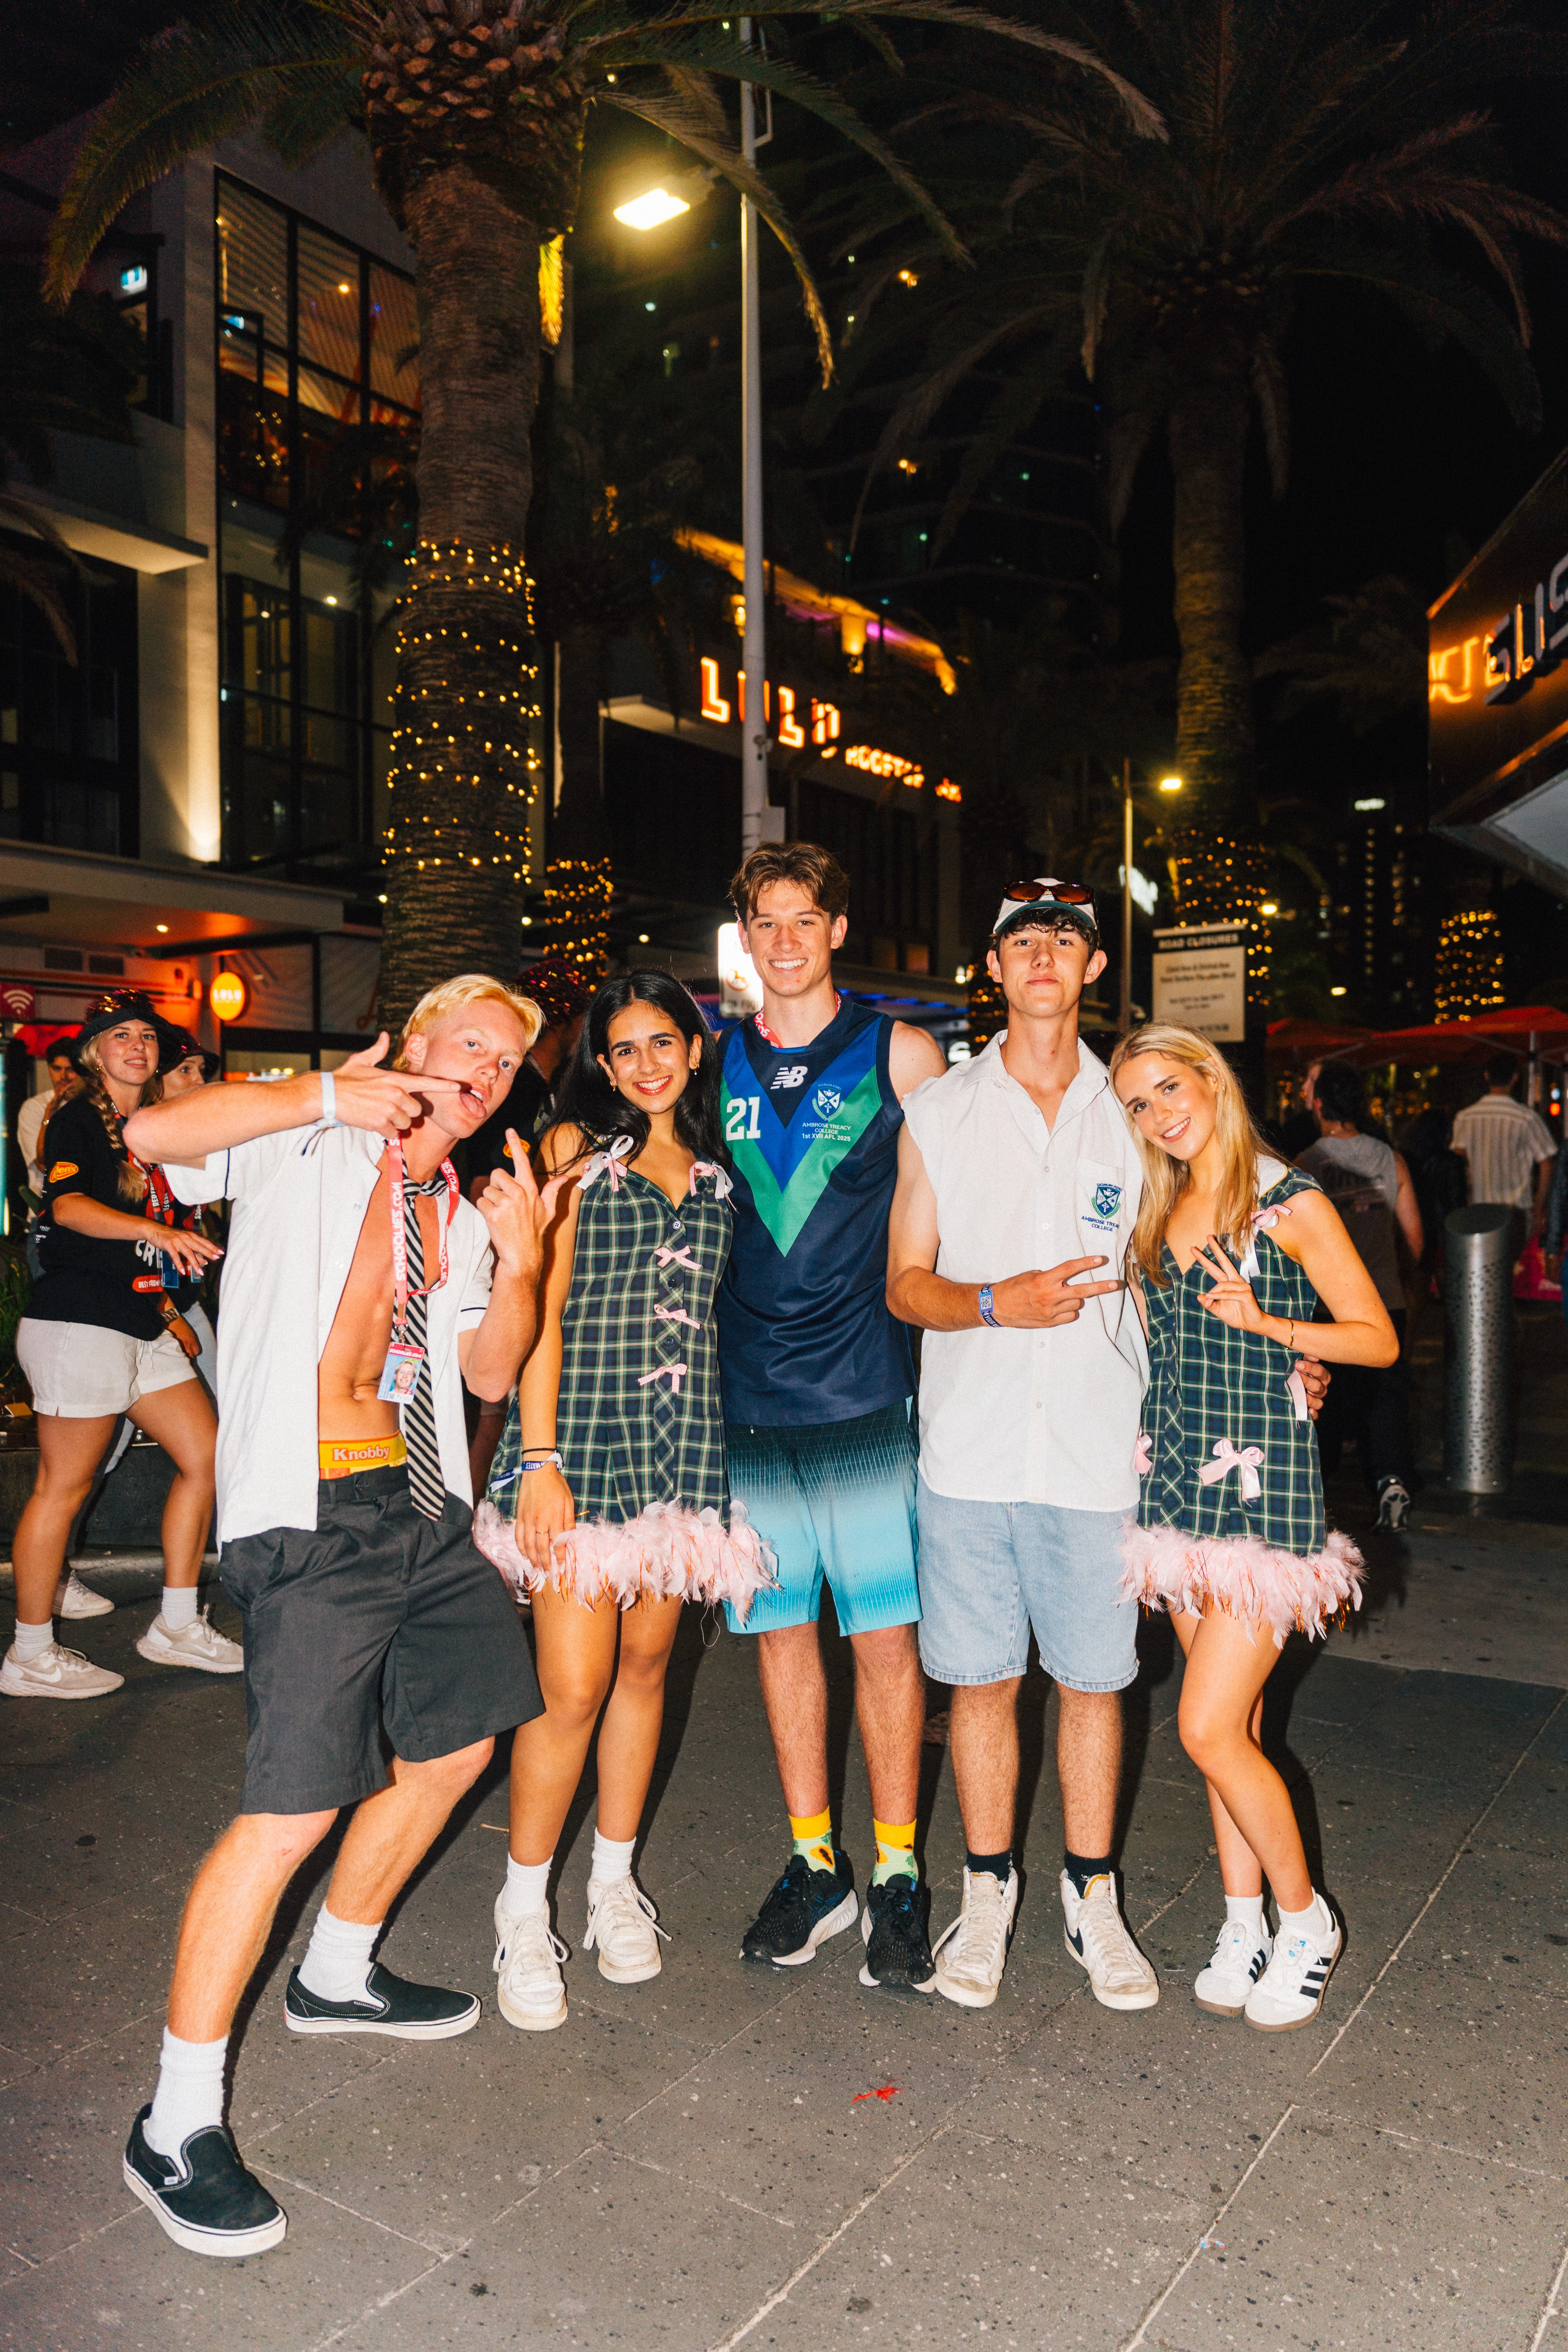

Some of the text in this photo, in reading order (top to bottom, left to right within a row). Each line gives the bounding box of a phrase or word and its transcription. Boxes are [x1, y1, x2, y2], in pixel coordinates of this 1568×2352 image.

[726, 1096, 761, 1142] 21
[151, 1194, 160, 1207] RED
[1081, 1216, 1105, 1225] AMBROSE
[391, 1182, 406, 1281] SCHOOLIES.COM
[984, 1315, 996, 1325] YOUR
[333, 1445, 389, 1461] Knobby
